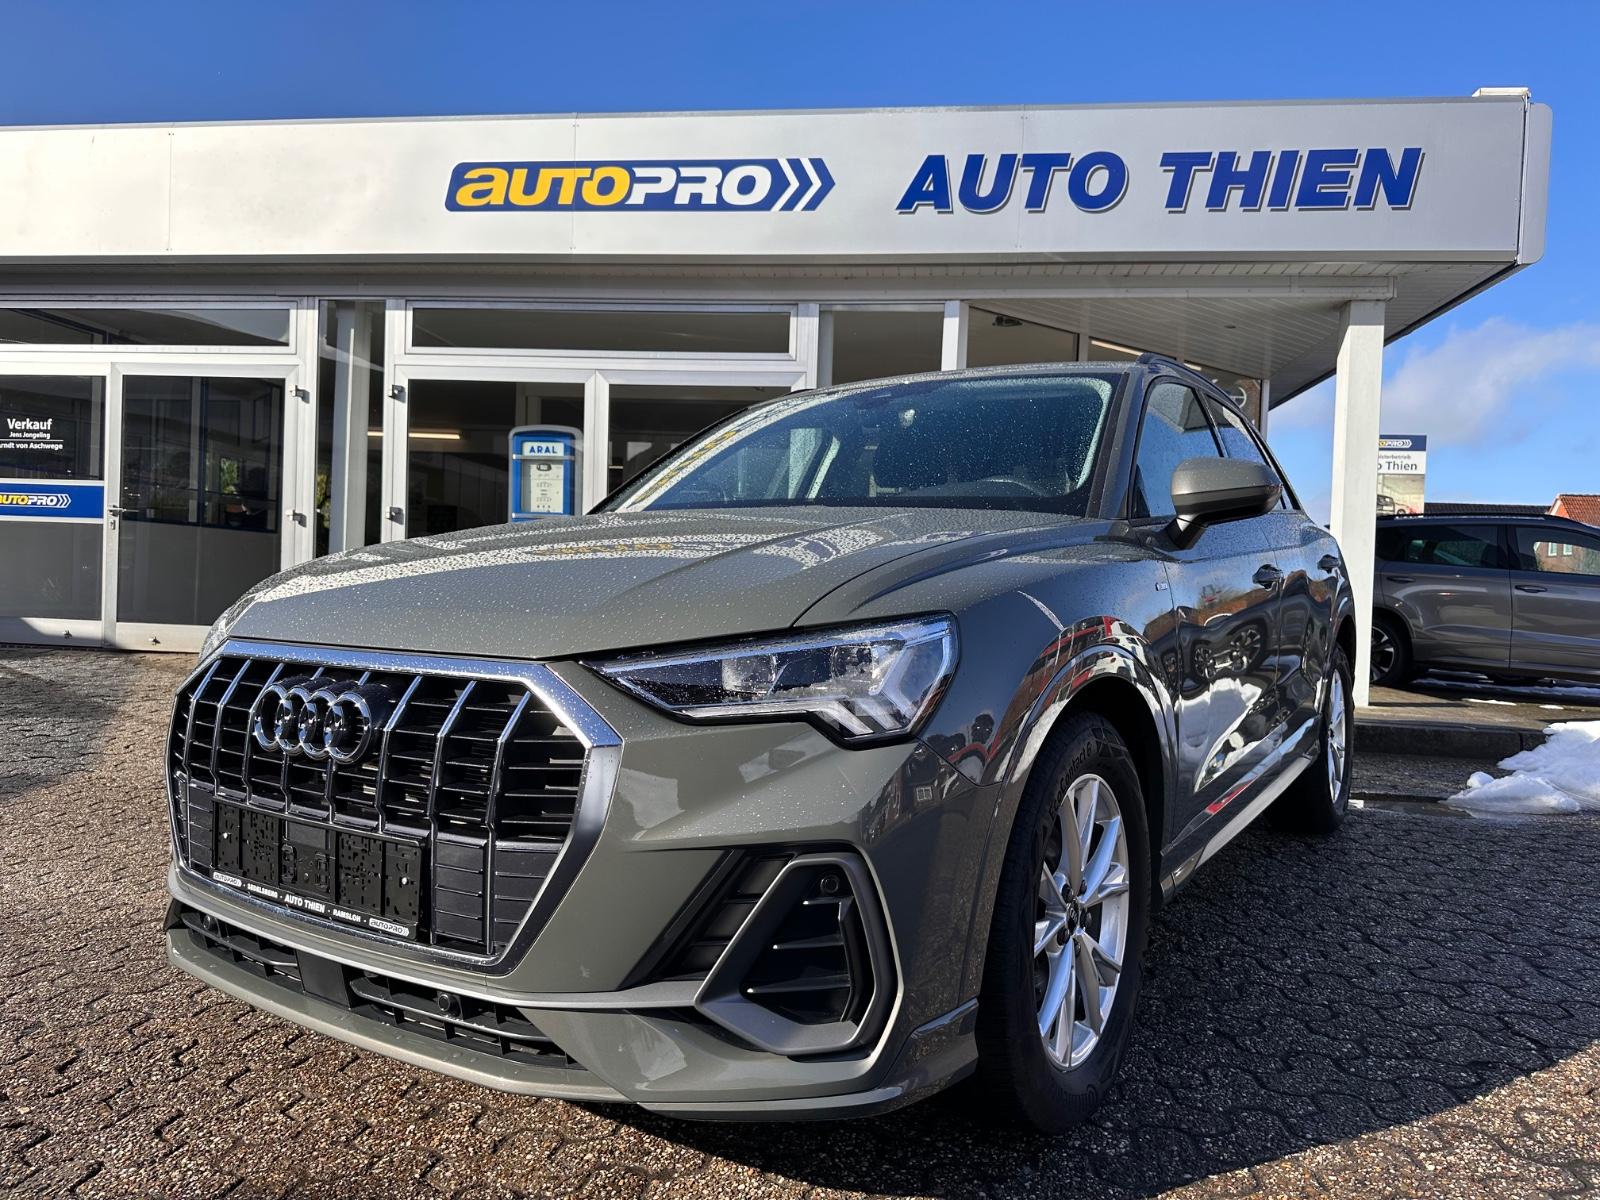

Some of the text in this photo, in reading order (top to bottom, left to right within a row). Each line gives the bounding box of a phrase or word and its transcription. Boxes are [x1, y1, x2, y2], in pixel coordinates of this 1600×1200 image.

[896, 147, 1426, 213] AUTO THIEN
[7, 418, 53, 430] Verkauf
[22, 431, 51, 440] Jongeling
[29, 442, 63, 450] Aschwege
[529, 446, 558, 454] ARAL
[1385, 461, 1418, 471] Thien
[0, 495, 58, 506] UTOPRO
[284, 894, 303, 907] AUTO
[304, 899, 326, 914] THIEN
[332, 908, 361, 923] RAMSLOH
